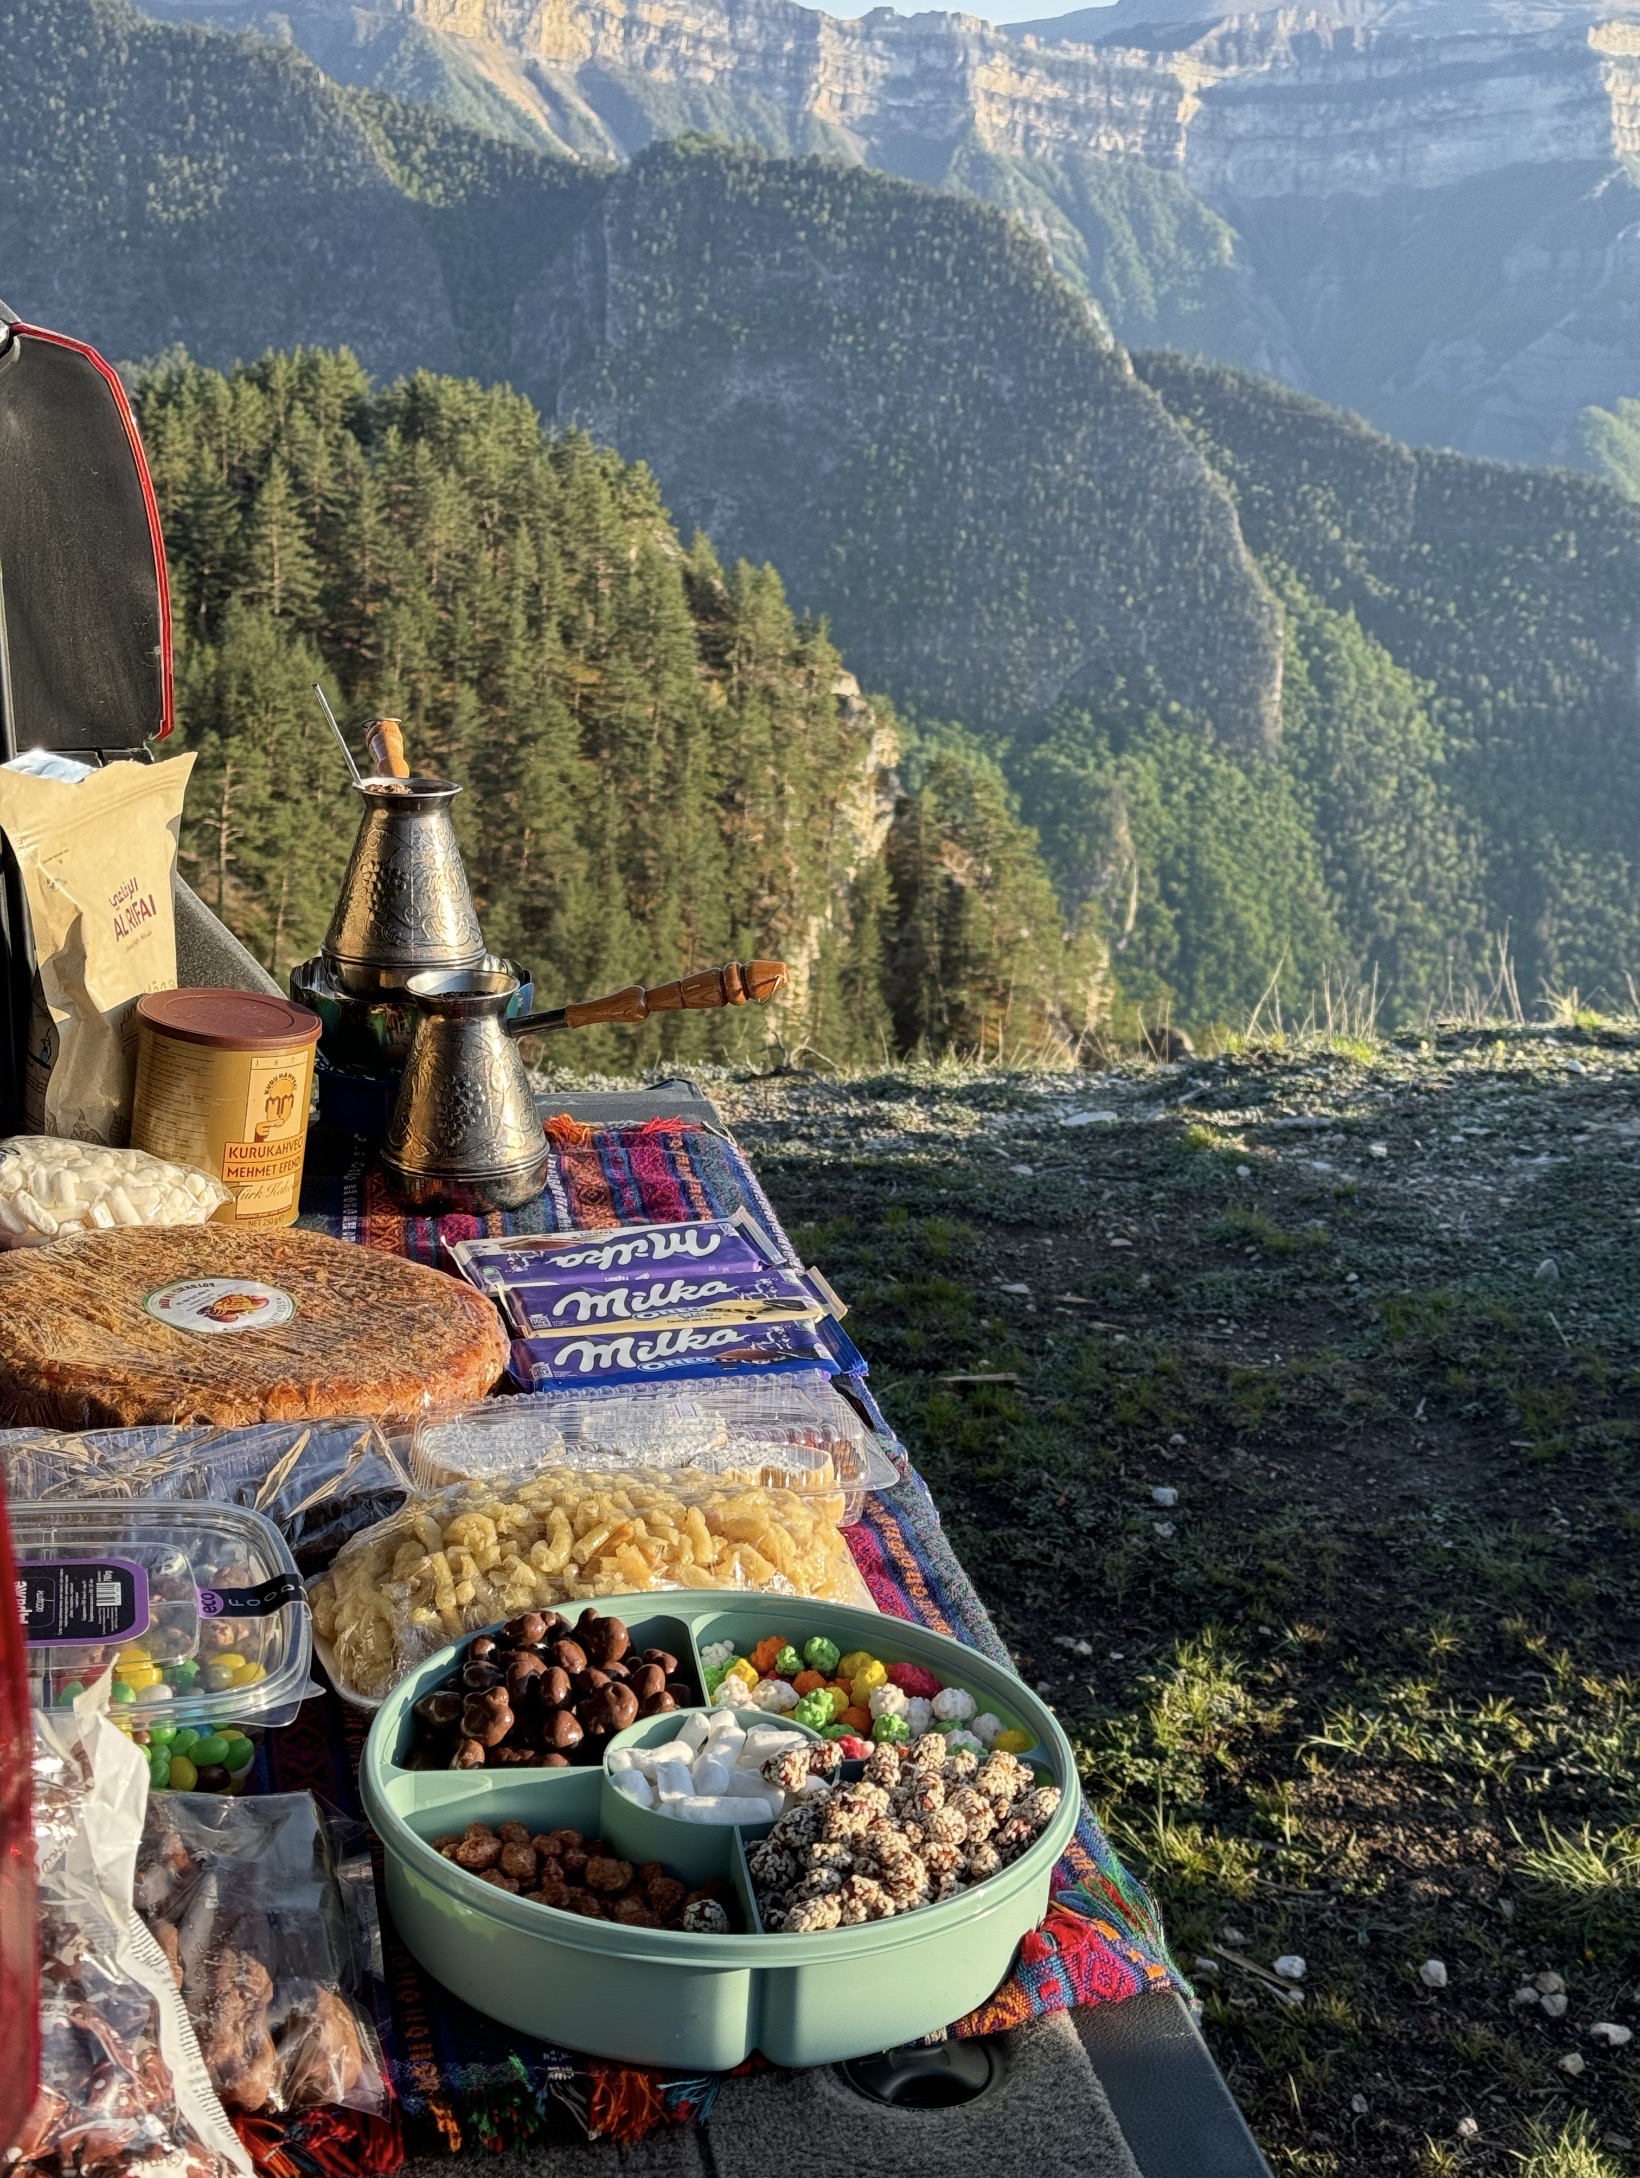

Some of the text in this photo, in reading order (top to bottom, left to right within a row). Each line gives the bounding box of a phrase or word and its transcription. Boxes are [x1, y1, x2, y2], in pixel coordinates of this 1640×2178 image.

[227, 1164, 277, 1178] MEHMET
[548, 1229, 721, 1271] Milka
[553, 1280, 732, 1322] Milka
[633, 1307, 703, 1320] OREO
[554, 1328, 747, 1373] Milka
[638, 1357, 713, 1371] OREO
[200, 1592, 218, 1614] eco
